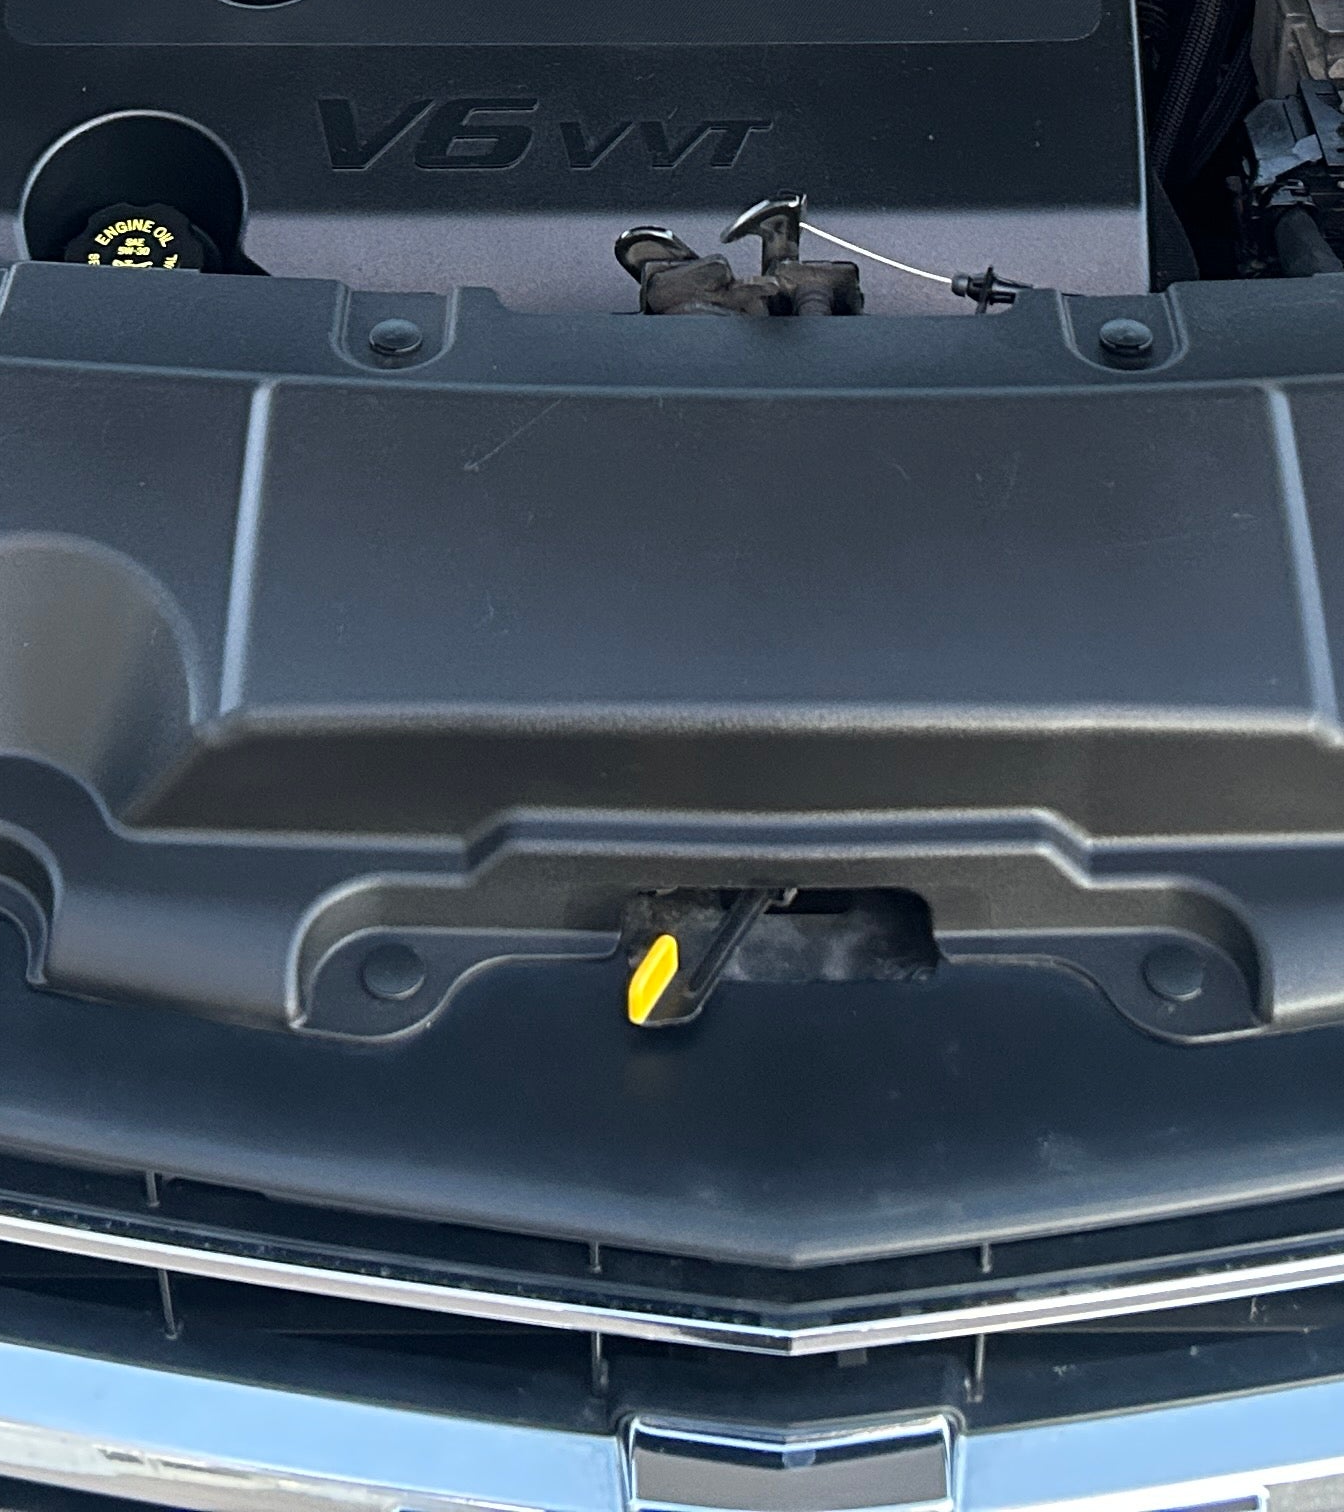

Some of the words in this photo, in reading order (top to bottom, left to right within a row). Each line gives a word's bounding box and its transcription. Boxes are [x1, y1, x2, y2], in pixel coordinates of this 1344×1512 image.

[316, 97, 538, 171] V6
[559, 119, 774, 169] VVT
[94, 218, 156, 246] ENGINE
[153, 226, 175, 248] OIL
[124, 237, 146, 247] SAE
[117, 246, 151, 256] 5W-30
